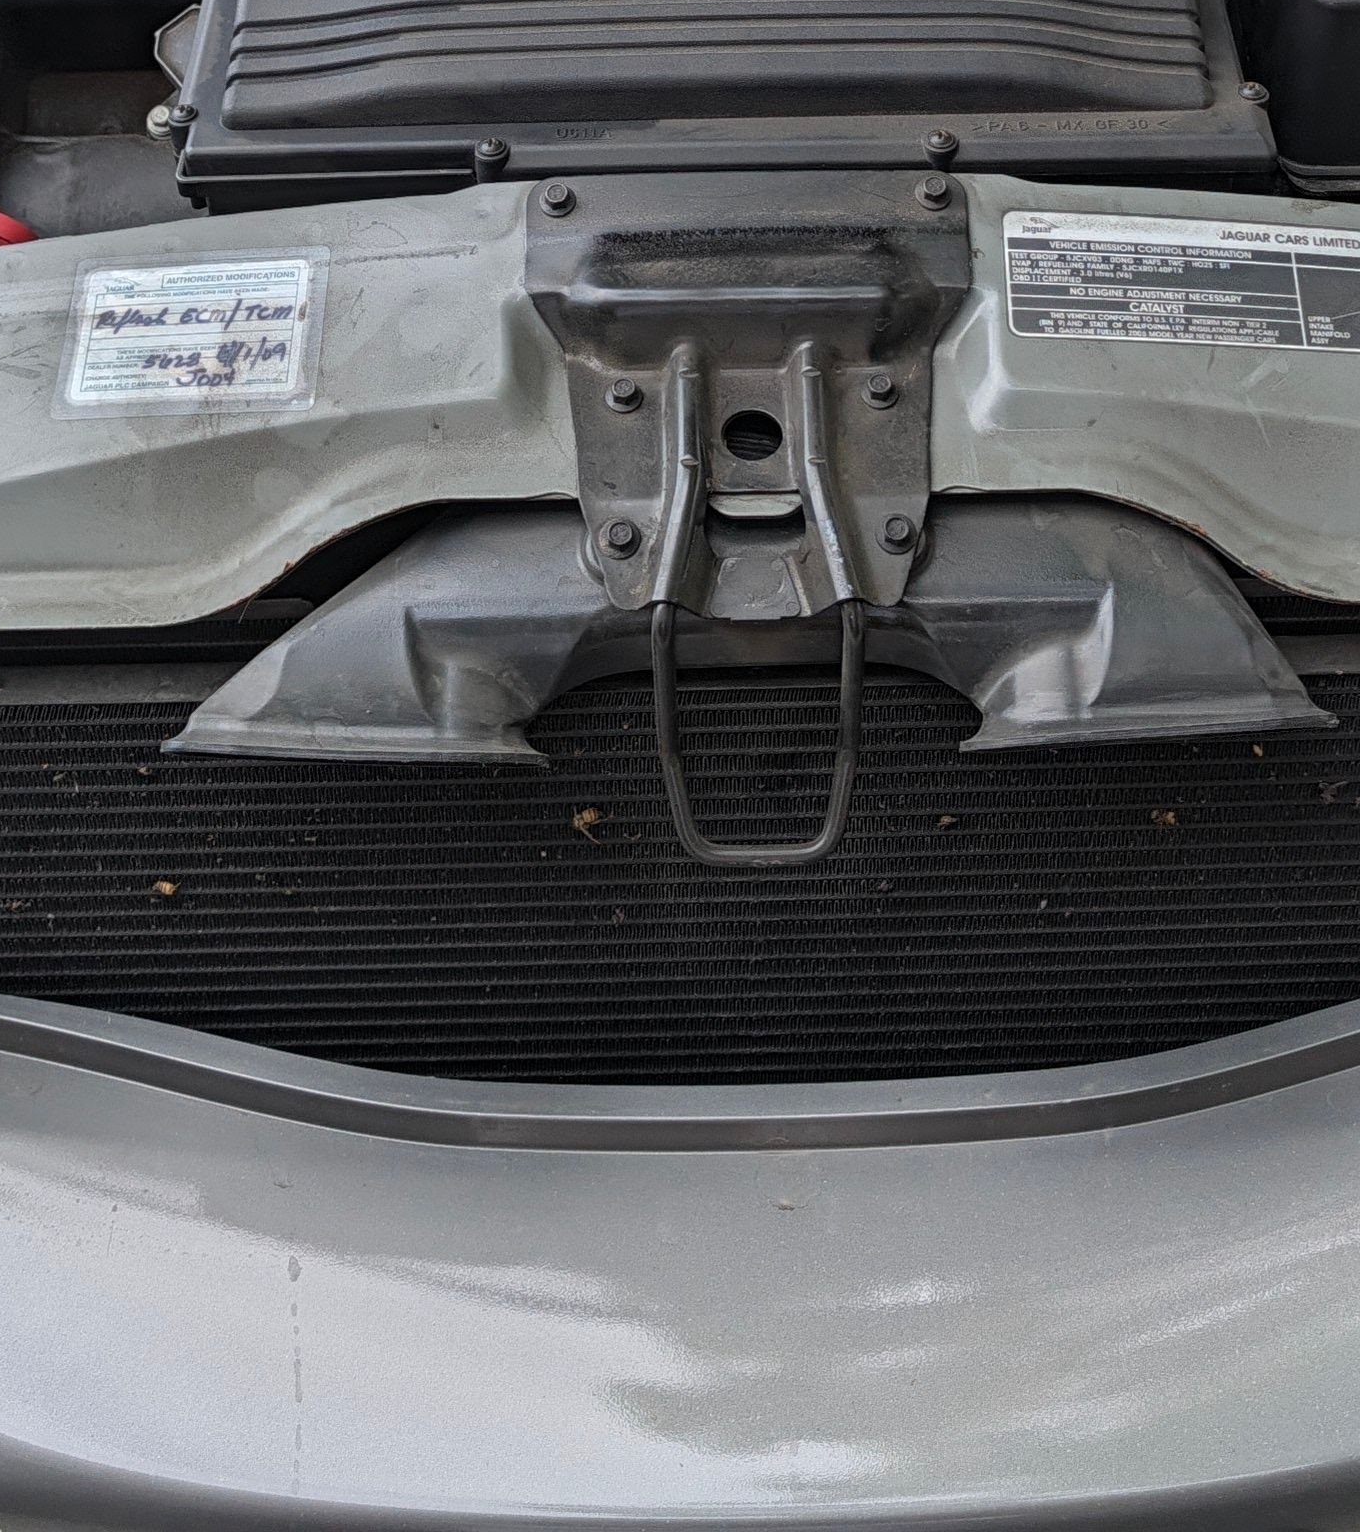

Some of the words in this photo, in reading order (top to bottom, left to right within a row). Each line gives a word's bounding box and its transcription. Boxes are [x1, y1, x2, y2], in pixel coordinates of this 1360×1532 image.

[1219, 230, 1271, 243] JAGUAR
[1274, 234, 1309, 246] CARS
[1029, 252, 1059, 261] GROUP
[1049, 240, 1088, 251] VEHICLE
[1090, 242, 1135, 253] EMISSION
[1137, 244, 1184, 256] CONTROL
[1185, 248, 1252, 260] INFORMATION
[1011, 259, 1032, 267] EVAP
[1038, 260, 1087, 269] REFUELLING
[1086, 262, 1115, 271] FAMILY
[1012, 267, 1072, 276] DISPLACEMENT
[166, 274, 223, 285] AUTHORIZED
[225, 270, 296, 282] MODIFICATIONS
[1042, 275, 1082, 283] CERTIFIED
[1069, 287, 1086, 296] NO
[1088, 288, 1125, 298] ENGINE
[1126, 289, 1186, 301] ADJUSTMENT
[1188, 293, 1243, 304] NECESSARY
[1128, 302, 1185, 314] CATALYST
[1066, 313, 1096, 321] VEHICLE
[1097, 314, 1140, 322] CONFORMS
[1191, 318, 1221, 327] INTERIM
[1307, 315, 1331, 323] UPPER
[1044, 326, 1055, 334] TO
[1058, 327, 1095, 336] GASOLINE
[1096, 328, 1127, 336] FUELLED
[1176, 332, 1195, 340] YEAR
[1214, 334, 1255, 343] PASSENGER
[1256, 335, 1277, 344] CARS
[1089, 320, 1109, 328] STATE
[1112, 321, 1123, 329] OF
[1126, 322, 1171, 332] CALIFORNIA
[1188, 325, 1238, 335] REGULATIONS
[1238, 328, 1280, 337] APPLICABLE
[1310, 330, 1351, 339] MANIFOLD
